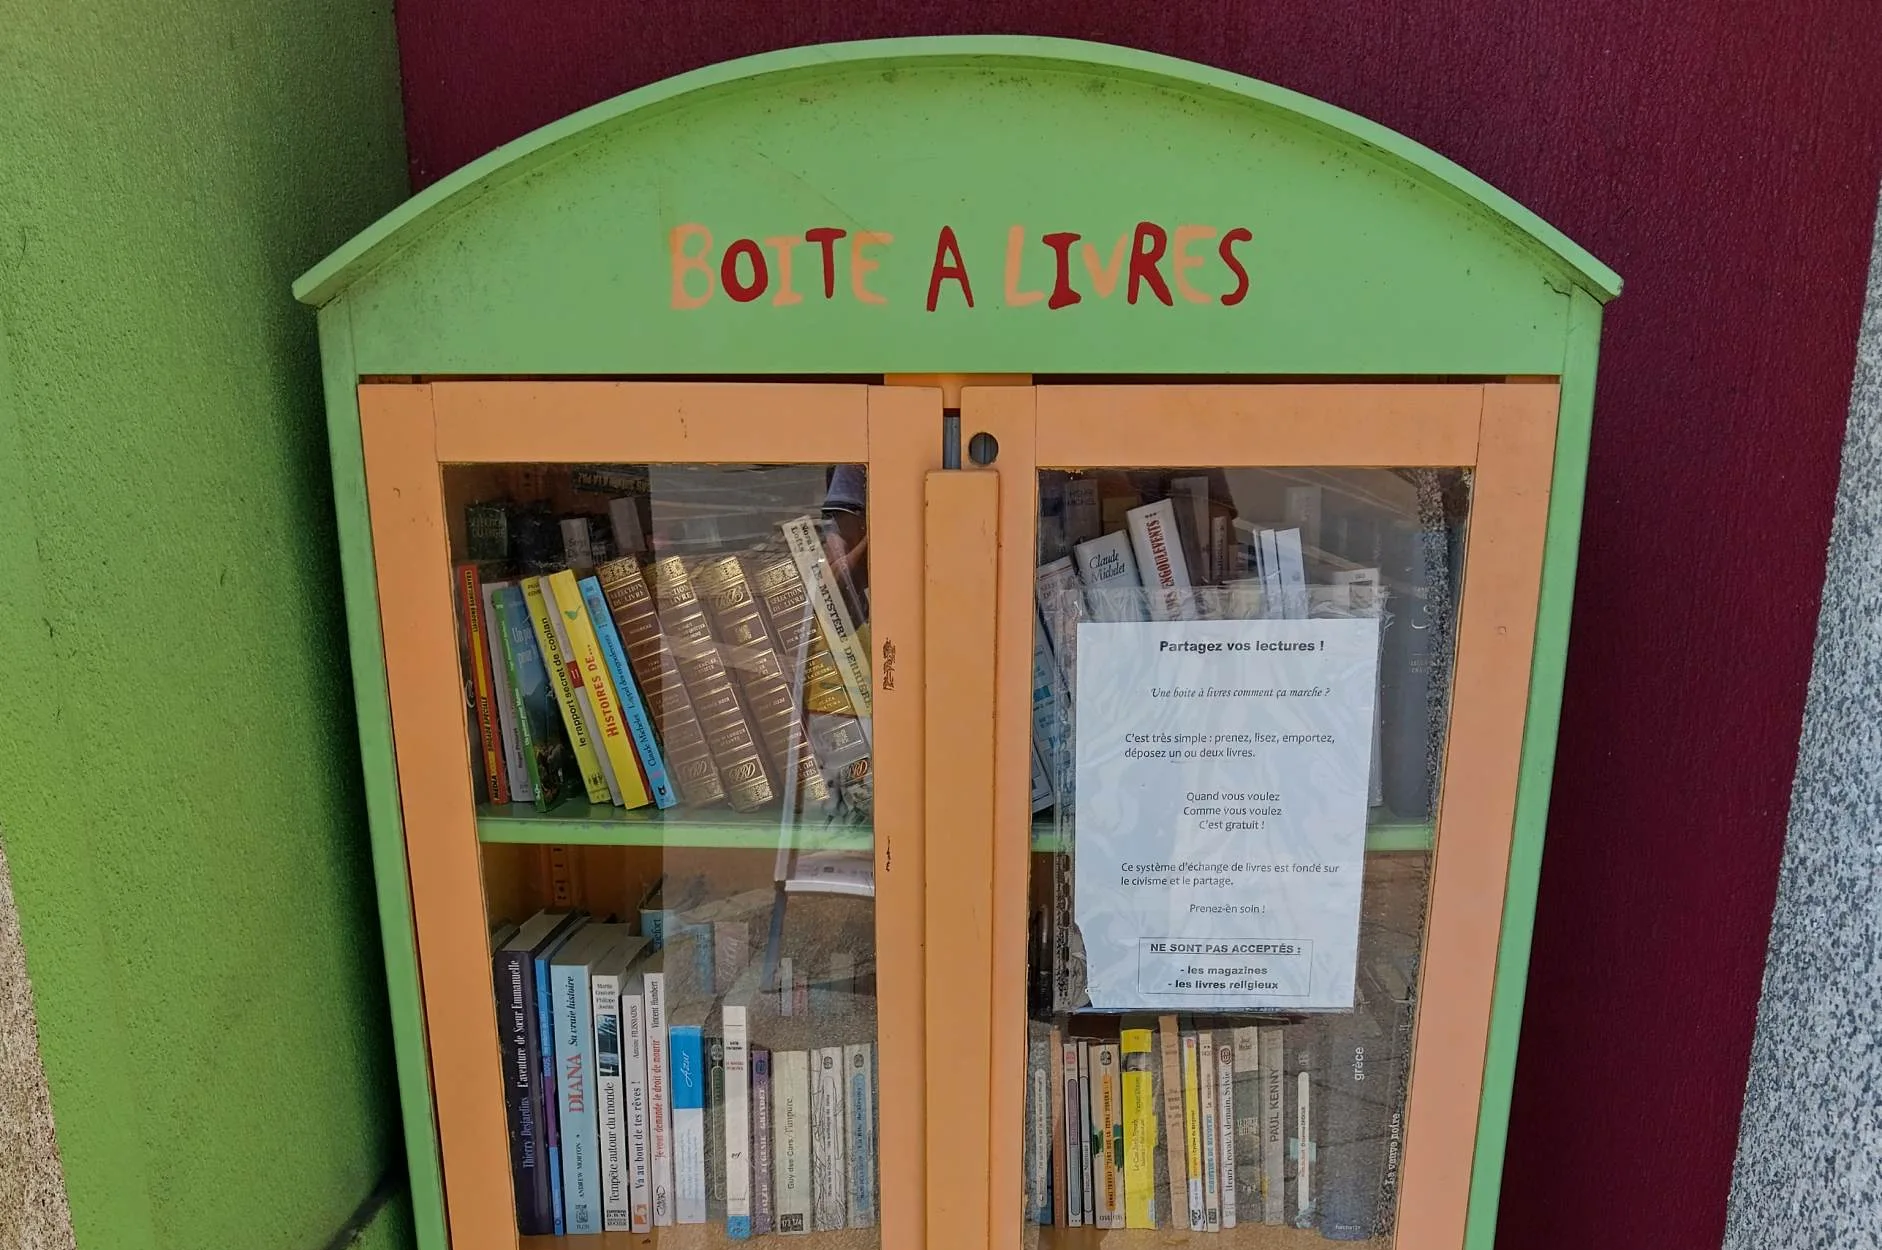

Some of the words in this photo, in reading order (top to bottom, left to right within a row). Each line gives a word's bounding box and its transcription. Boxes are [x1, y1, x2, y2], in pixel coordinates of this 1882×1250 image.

[670, 223, 895, 310] BOITE
[926, 225, 975, 313] A
[1004, 221, 1254, 310] LIVRES
[1088, 549, 1120, 569] Claude
[1145, 519, 1175, 590] ENGOULEVENTS
[542, 617, 557, 651] coplan
[1159, 640, 1222, 655] Partagez
[1227, 642, 1251, 652] vos
[1255, 640, 1315, 652] lectures
[552, 653, 562, 666] de
[556, 666, 572, 699] secret
[1151, 687, 1171, 698] Une
[1206, 686, 1232, 698] livres
[1233, 688, 1274, 698] comment
[1276, 688, 1287, 700] ça
[1289, 686, 1322, 698] marche
[591, 675, 620, 738] HISTOIRES
[566, 699, 584, 736] rapport
[578, 736, 587, 747] le
[1125, 732, 1149, 744] C'est
[1151, 732, 1172, 744] très
[1174, 732, 1207, 747] simple
[1214, 734, 1252, 747] prenez,
[1254, 732, 1280, 746] lisez,
[1282, 733, 1335, 747] emportez,
[642, 744, 657, 767] Claude
[1124, 747, 1167, 762] déposez
[1168, 750, 1182, 759] un
[1184, 750, 1197, 759] ou
[1199, 747, 1224, 759] deux
[1226, 747, 1256, 759] livres.
[1186, 791, 1220, 803] Quand
[1221, 793, 1245, 802] vous
[1247, 791, 1280, 802] voulez
[1183, 806, 1221, 817] Comme
[1223, 807, 1247, 817] vous
[1249, 806, 1282, 817] voulez
[1199, 820, 1223, 830] C'est
[1225, 820, 1259, 833] gratuit
[1121, 862, 1133, 873] Ce
[1135, 862, 1176, 876] système
[1178, 862, 1229, 876] d'échange
[1231, 862, 1243, 873] de
[1245, 862, 1272, 873] livres
[1274, 864, 1289, 873] est
[1291, 862, 1321, 874] fondé
[1323, 865, 1340, 874] sur
[1120, 876, 1129, 886] le
[1131, 876, 1168, 886] civisme
[1169, 877, 1180, 886] et
[1182, 876, 1191, 886] le
[1193, 877, 1234, 889] partage.
[1239, 903, 1260, 914] soin
[1150, 943, 1166, 953] NE
[1169, 944, 1203, 954] SONT
[1205, 944, 1229, 954] PAS
[1231, 943, 1294, 954] ACCEPTÉS
[1187, 965, 1205, 975] les
[1207, 966, 1268, 978] magazines
[507, 959, 523, 1010] Emmanuelle
[564, 975, 577, 1010] histoire
[1175, 979, 1193, 989] les
[1195, 980, 1226, 990] livres
[1228, 980, 1279, 992] religieux
[564, 1010, 577, 1034] vraie
[649, 1006, 660, 1029] Vincent
[513, 1034, 526, 1045] de
[567, 1034, 578, 1047] Sa
[515, 1047, 529, 1088] L'aventure
[650, 1064, 661, 1073] de
[679, 1049, 694, 1088] Azur
[1351, 1046, 1366, 1082] grèce
[565, 1053, 585, 1113] DIANA
[651, 1074, 662, 1093] droit
[1221, 1071, 1232, 1096] Sylvie
[1268, 1067, 1280, 1110] KENNY
[603, 1082, 616, 1116] monde
[630, 1087, 642, 1111] rêves
[651, 1093, 663, 1101] le
[518, 1096, 534, 1137] Desjardins
[604, 1117, 616, 1130] du
[632, 1113, 643, 1126] tes
[652, 1103, 664, 1133] demande
[1269, 1110, 1280, 1143] PAUL
[1388, 1112, 1401, 1140] noire
[632, 1128, 644, 1140] de
[521, 1139, 536, 1169] Thierry
[574, 1141, 584, 1171] MORTON
[606, 1130, 618, 1162] autour
[633, 1142, 645, 1162] bout
[785, 1139, 795, 1157] Cars
[1387, 1141, 1398, 1170] veuve
[634, 1165, 645, 1176] au
[786, 1158, 795, 1173] des
[575, 1171, 585, 1200] ANDREW
[607, 1163, 622, 1204] Tempête
[633, 1177, 645, 1189] Va
[786, 1174, 796, 1189] Guy
[1224, 1169, 1234, 1192] Henri
